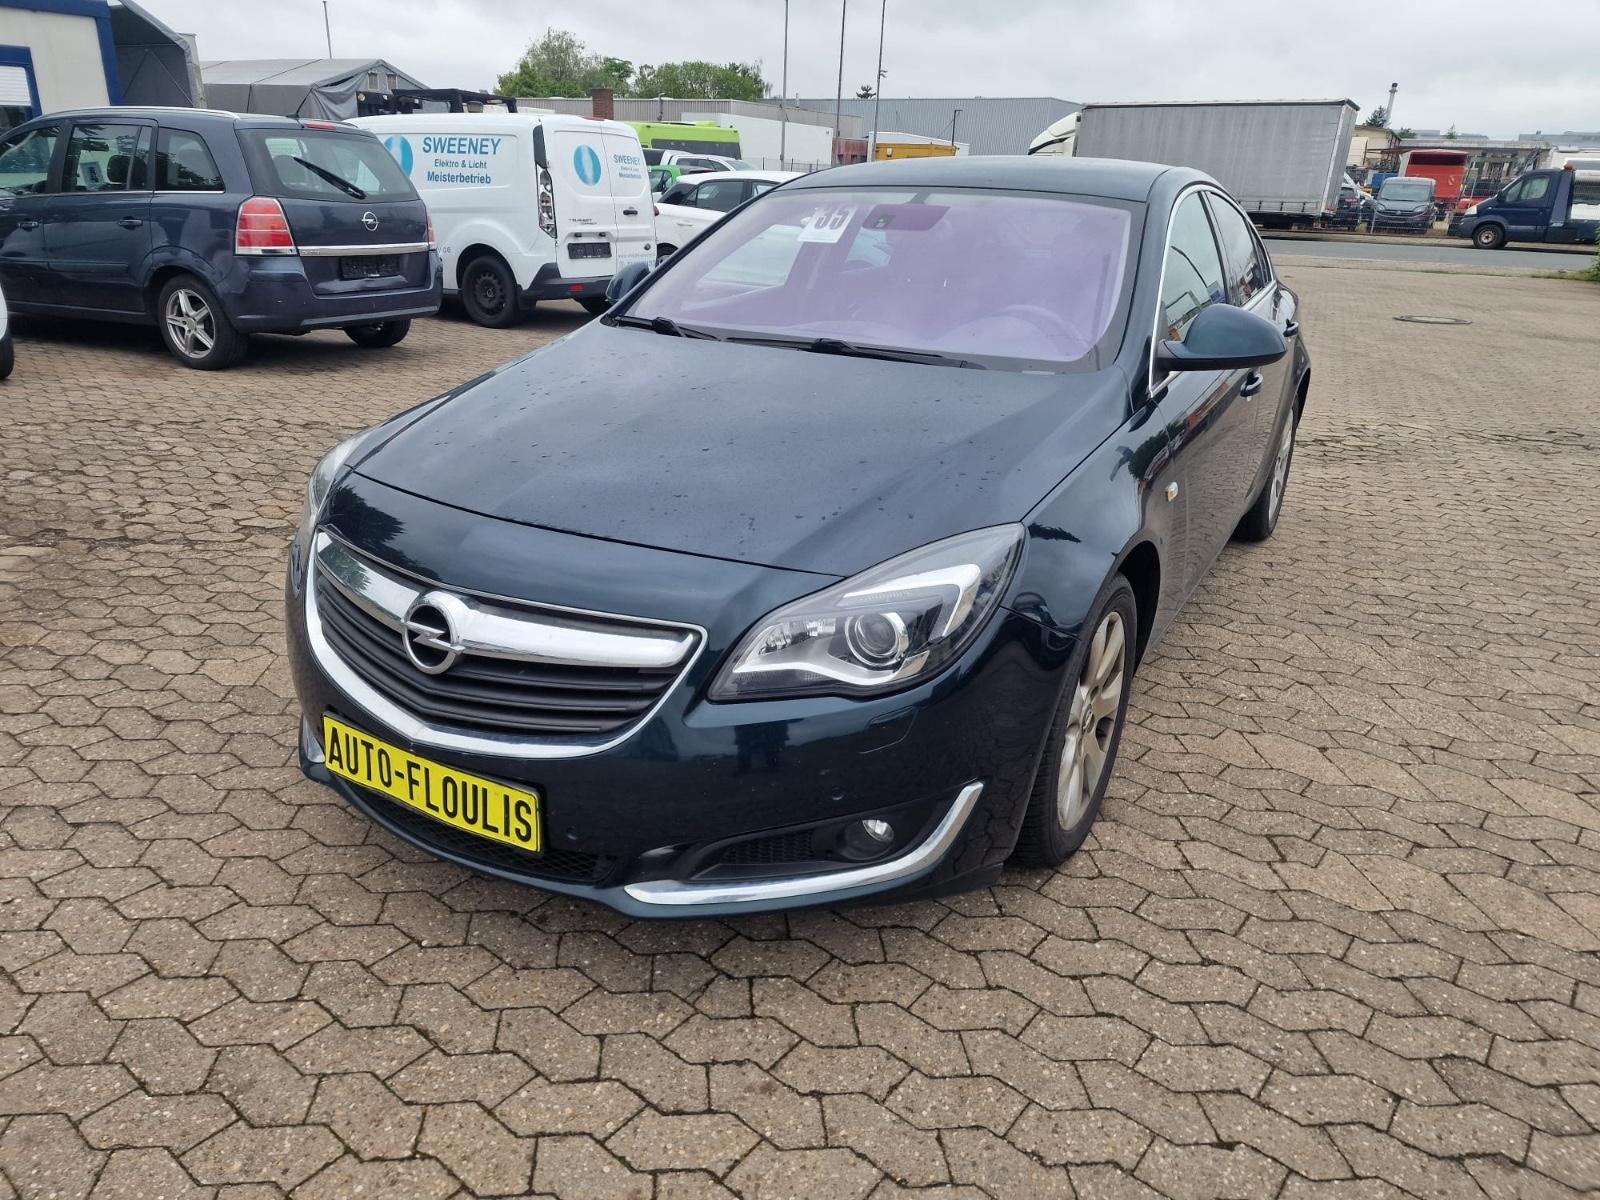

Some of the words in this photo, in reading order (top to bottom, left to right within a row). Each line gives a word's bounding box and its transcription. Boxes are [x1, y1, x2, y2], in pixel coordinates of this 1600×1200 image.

[422, 136, 501, 155] SWEENEY
[434, 158, 459, 168] Elektro
[460, 159, 467, 168] &
[468, 160, 487, 169] Licht
[427, 171, 492, 184] Meisterbetrieb
[328, 726, 532, 842] AUTO-FLOULIS
